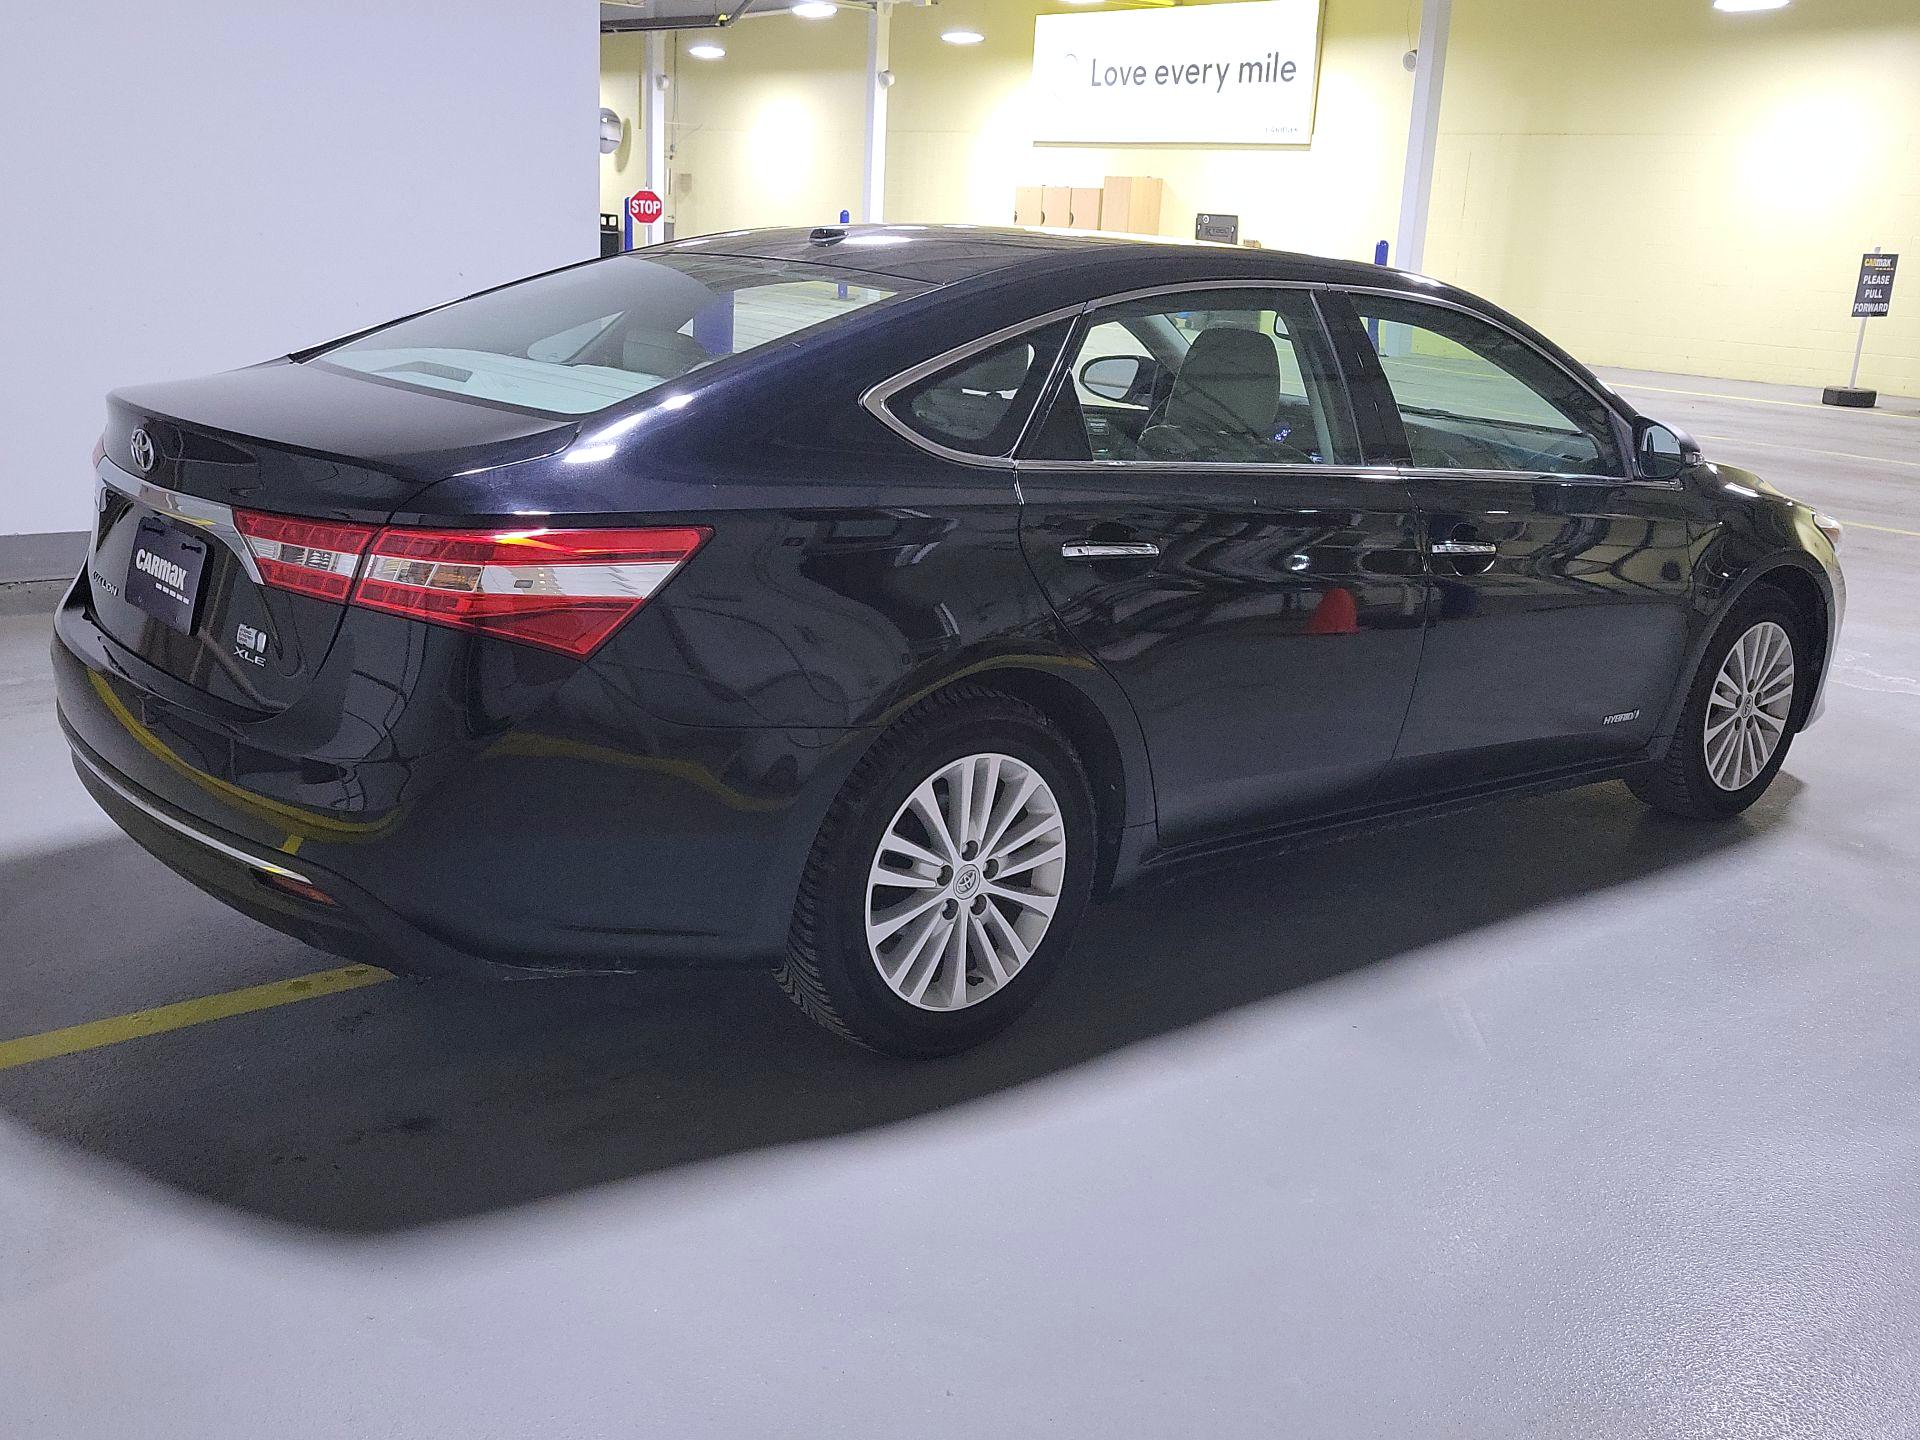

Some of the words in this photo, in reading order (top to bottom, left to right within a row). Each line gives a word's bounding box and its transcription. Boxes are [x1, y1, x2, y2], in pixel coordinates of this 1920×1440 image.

[1091, 58, 1147, 86] Love
[1154, 63, 1230, 93] every
[1238, 51, 1297, 83] mile
[631, 199, 661, 214] STOP
[1862, 275, 1890, 285] PLEASE
[1864, 289, 1883, 299] PULL
[1853, 303, 1888, 313] FORWARD
[135, 549, 187, 591] CARmax
[233, 645, 267, 668] XLE
[1602, 711, 1635, 725] HYBRID
